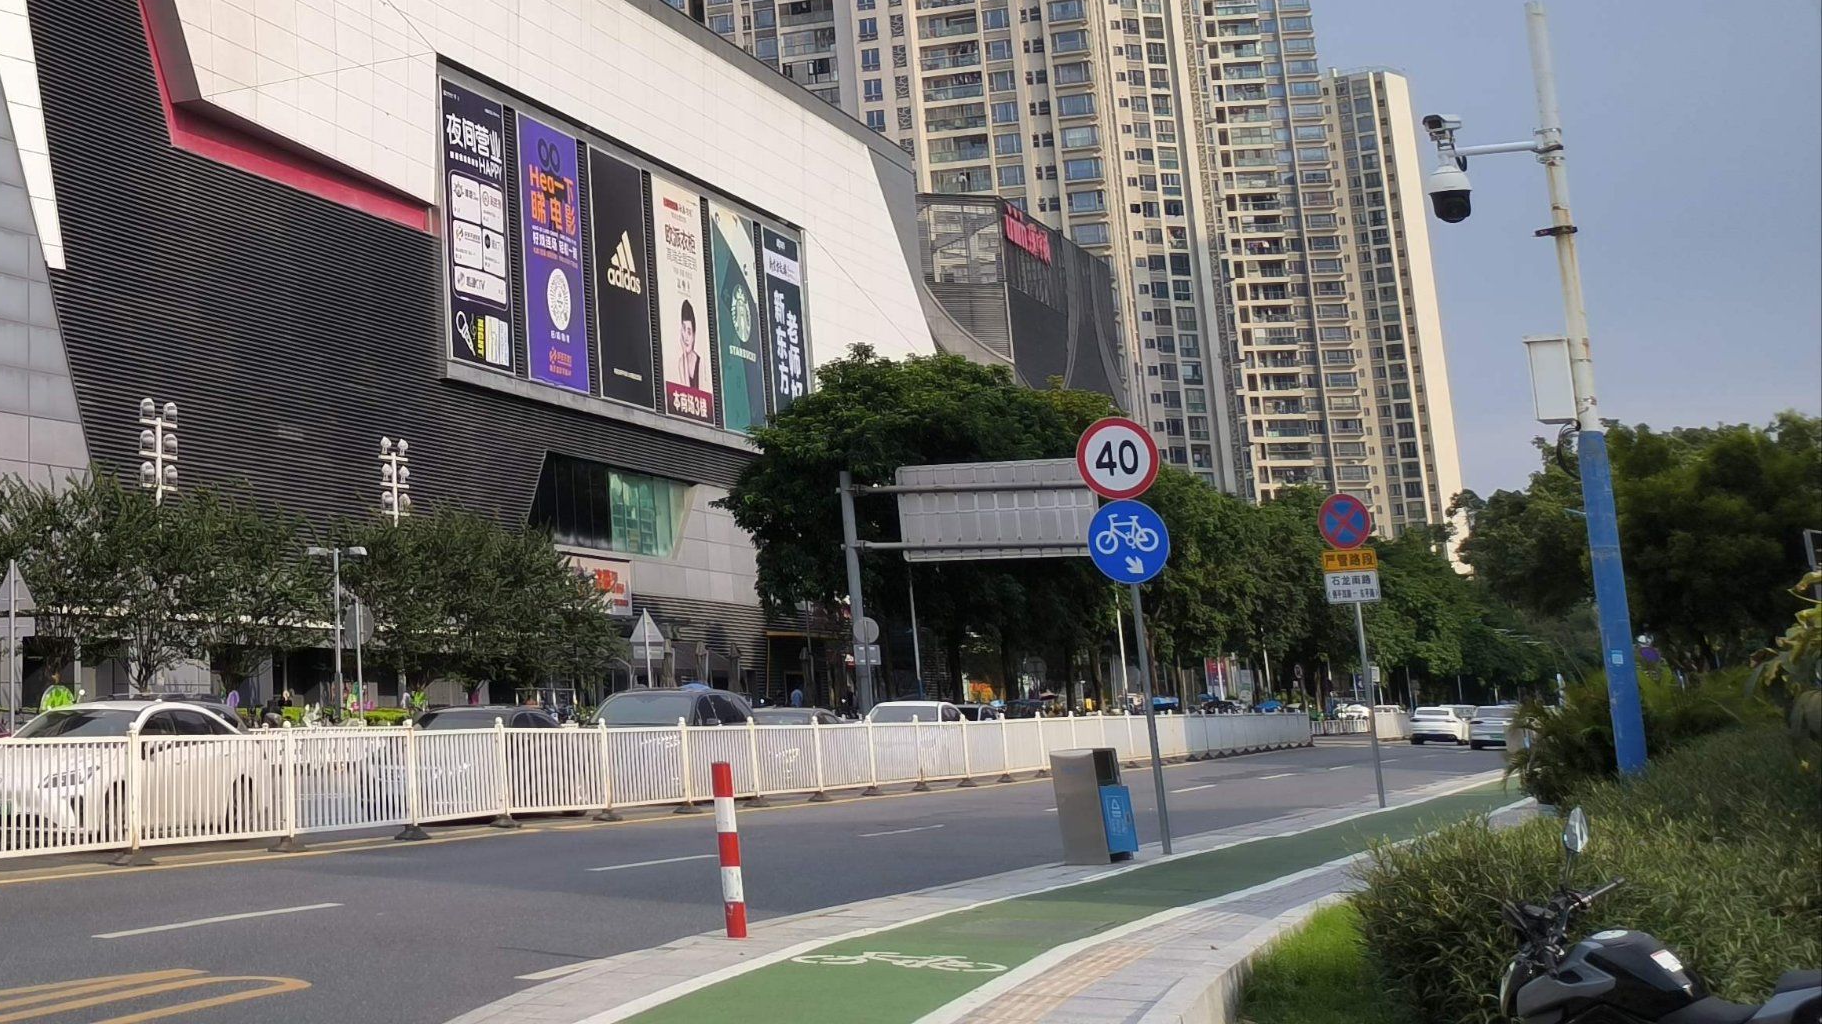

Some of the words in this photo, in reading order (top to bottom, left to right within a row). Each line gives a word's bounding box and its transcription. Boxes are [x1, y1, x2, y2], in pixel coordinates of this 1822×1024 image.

[445, 113, 503, 164] 夜间营业
[479, 157, 502, 180] HAPPY
[529, 164, 574, 202] Hea一下
[607, 264, 641, 295] adidas
[729, 345, 757, 363] STARBUCKS
[773, 289, 789, 394] 新东方
[1095, 439, 1139, 476] 40
[1325, 553, 1374, 567] 严管路段
[1331, 575, 1371, 585] 石龙南路
